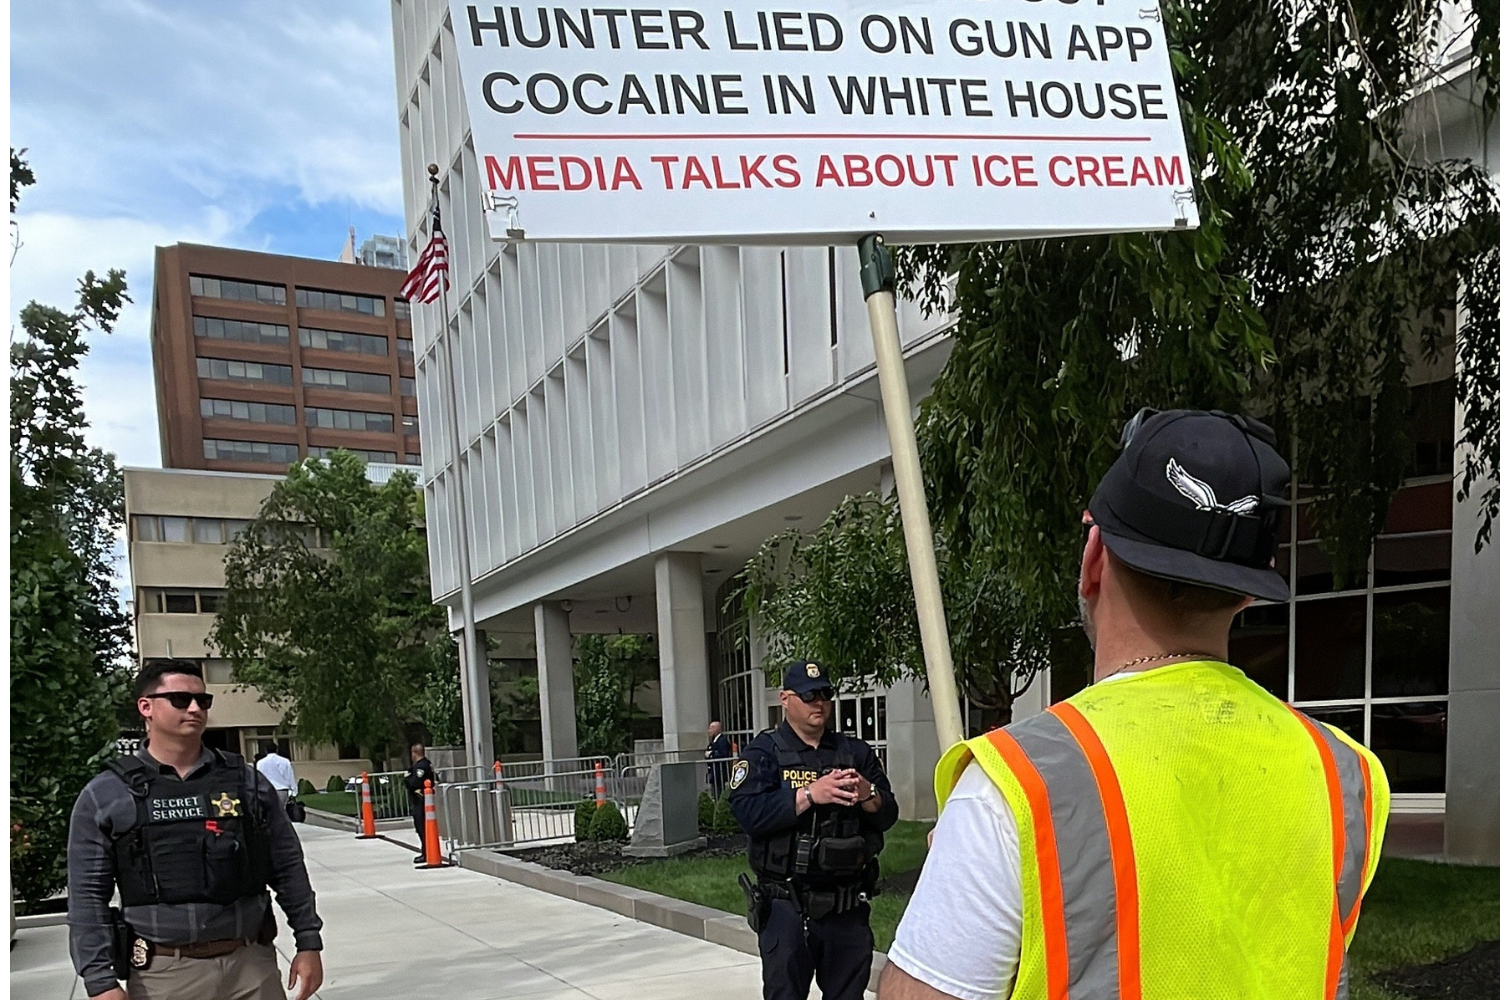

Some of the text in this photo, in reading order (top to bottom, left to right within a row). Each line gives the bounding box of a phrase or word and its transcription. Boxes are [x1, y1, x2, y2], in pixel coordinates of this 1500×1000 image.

[467, 5, 1152, 62] HUNTER LIED ON GUN APP
[482, 71, 1168, 120] COCAINE IN WHITE HOUSE
[484, 154, 1185, 191] MEDIA TALKS ABOUT ICE CREAM
[783, 770, 817, 781] POLICE
[152, 807, 204, 819] SERVICE
[153, 796, 199, 808] SECRET
